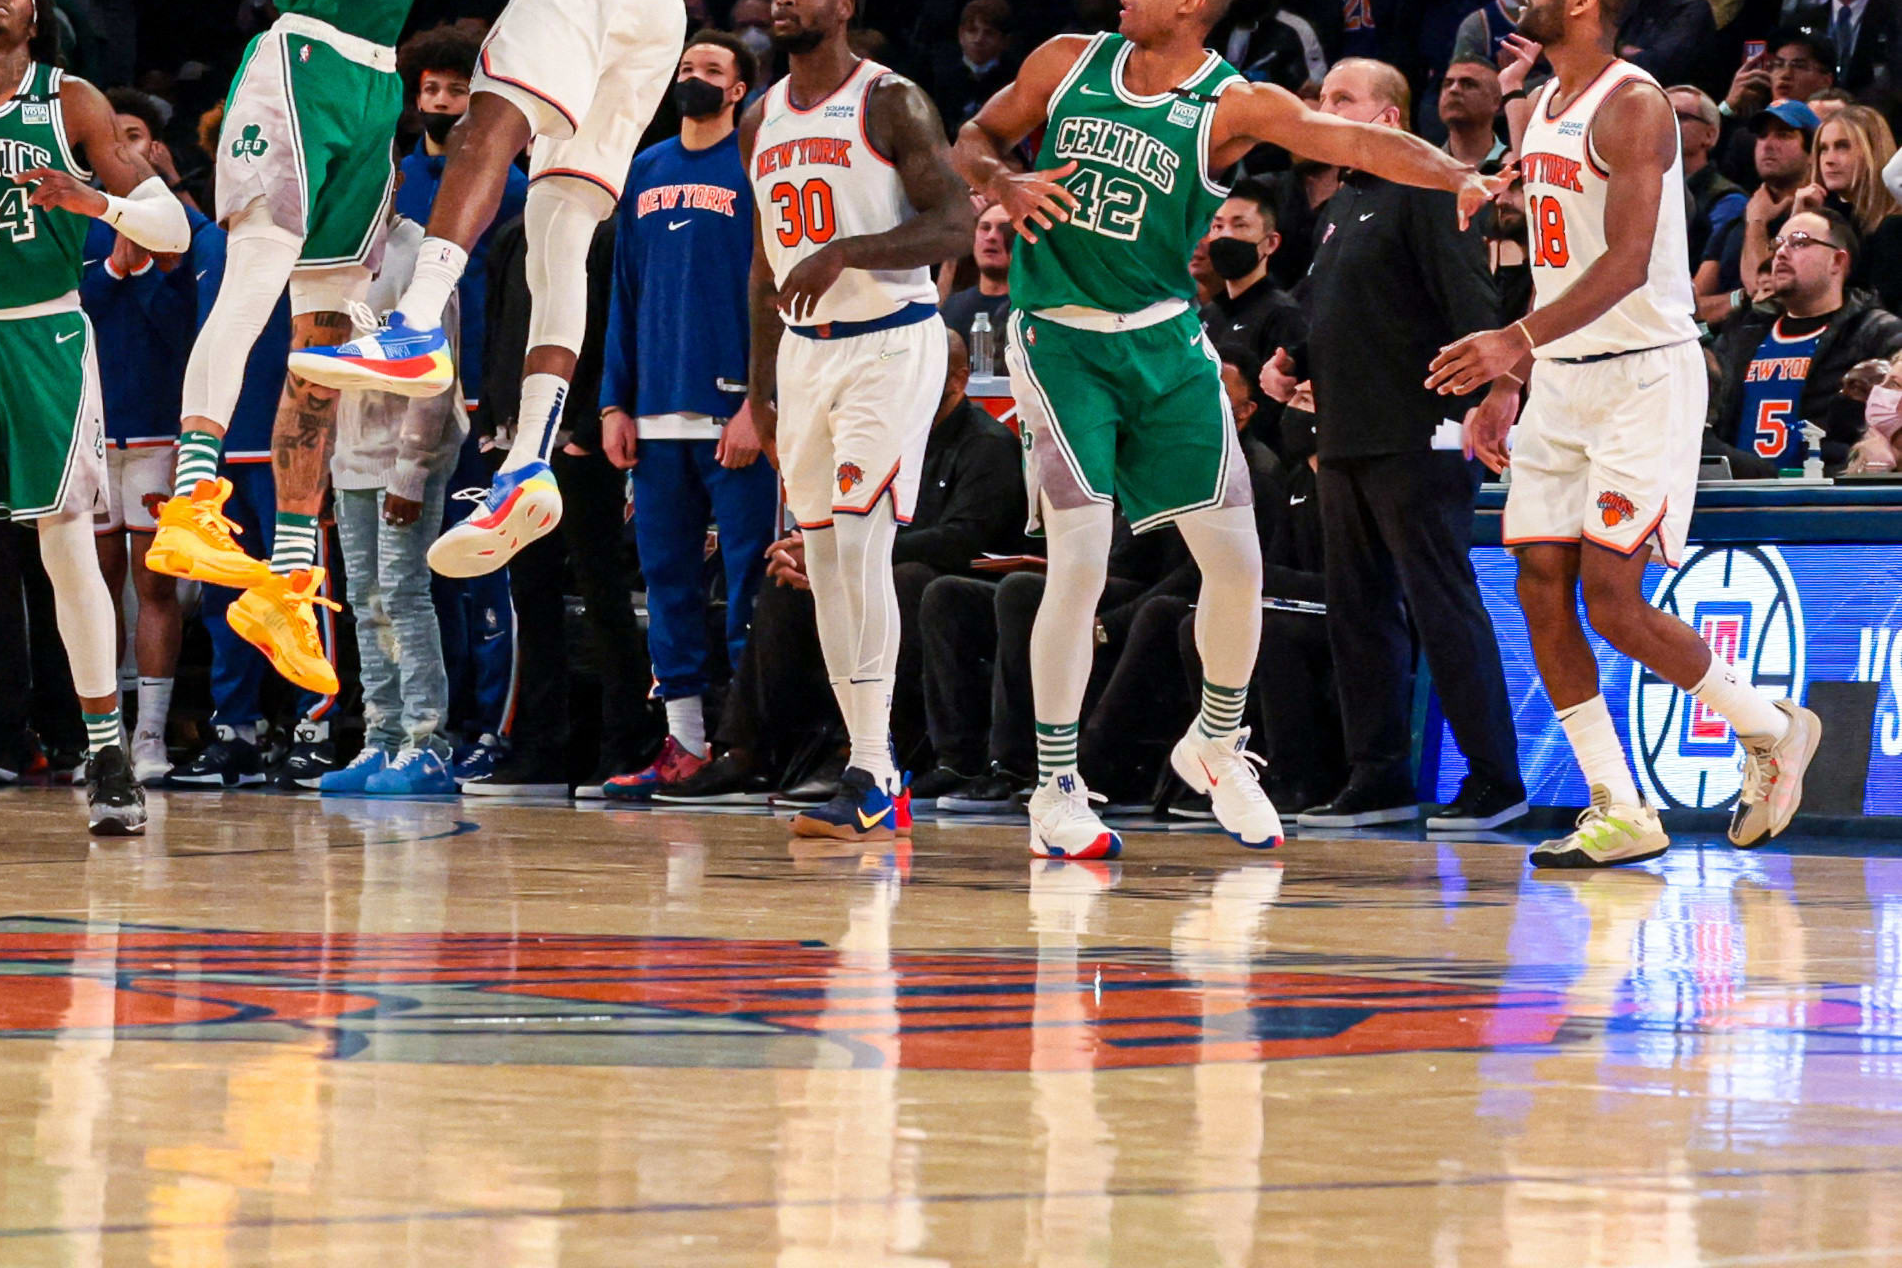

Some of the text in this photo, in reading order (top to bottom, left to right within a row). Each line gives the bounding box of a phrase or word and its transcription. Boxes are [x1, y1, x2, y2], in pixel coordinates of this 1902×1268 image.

[756, 137, 852, 181] NEW YORK
[1055, 115, 1181, 194] CELTICS
[637, 184, 737, 219] NEW YORK
[769, 177, 836, 248] 30
[1064, 168, 1147, 241] 42
[1529, 194, 1569, 268] 18
[1744, 359, 1779, 383] EW
[1753, 399, 1793, 458] 5
